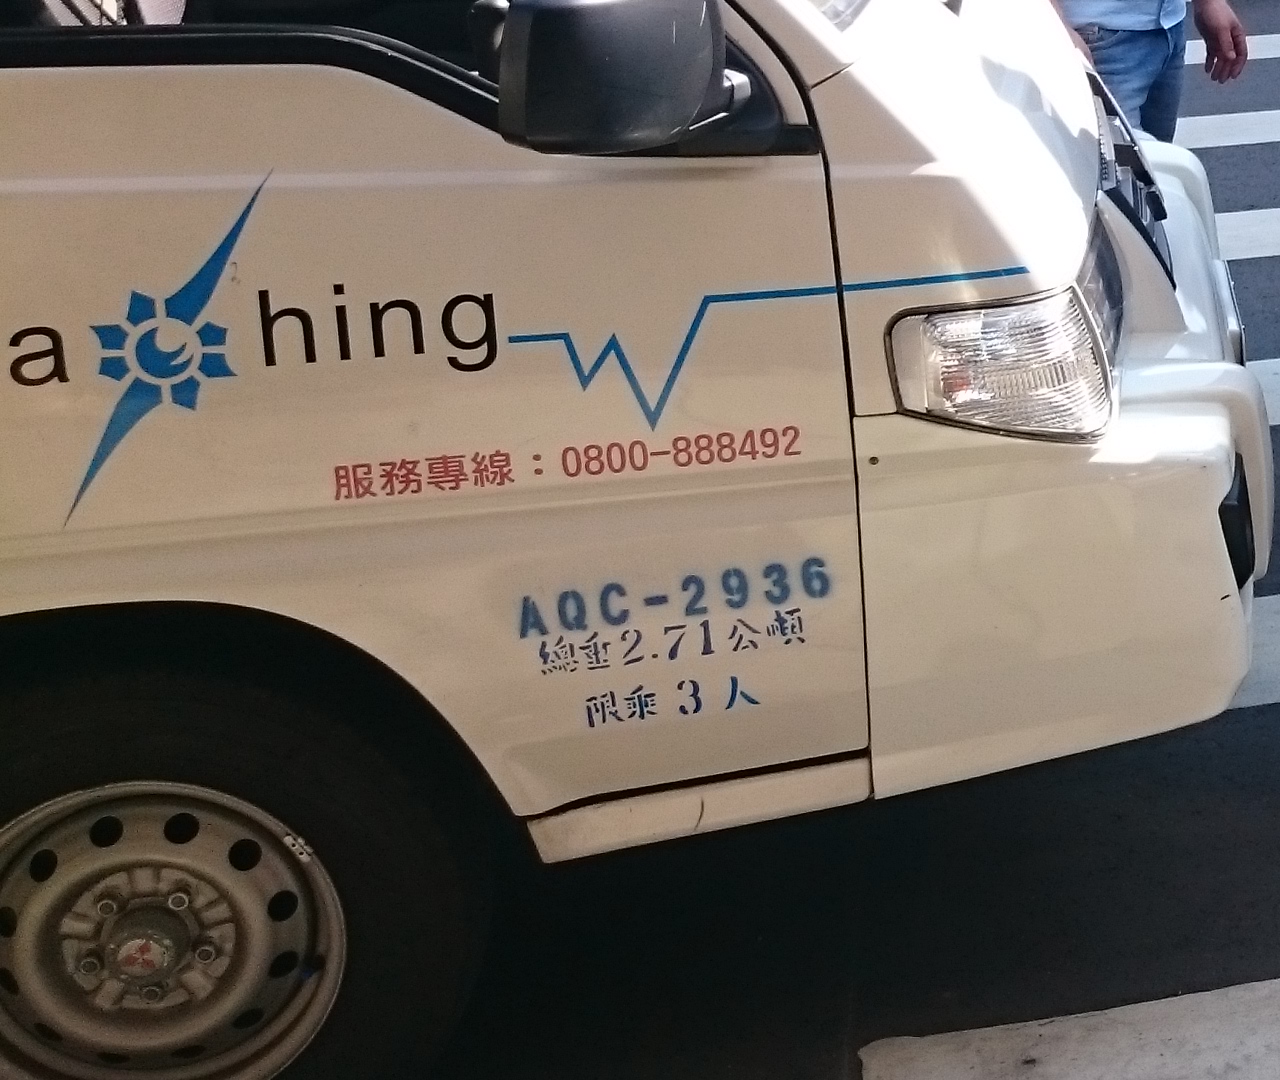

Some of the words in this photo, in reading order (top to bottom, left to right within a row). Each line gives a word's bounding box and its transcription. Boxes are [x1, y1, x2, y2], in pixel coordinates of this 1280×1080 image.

[257, 283, 500, 373] hing
[561, 425, 802, 478] 0800-888492
[519, 556, 831, 639] AQC-2936
